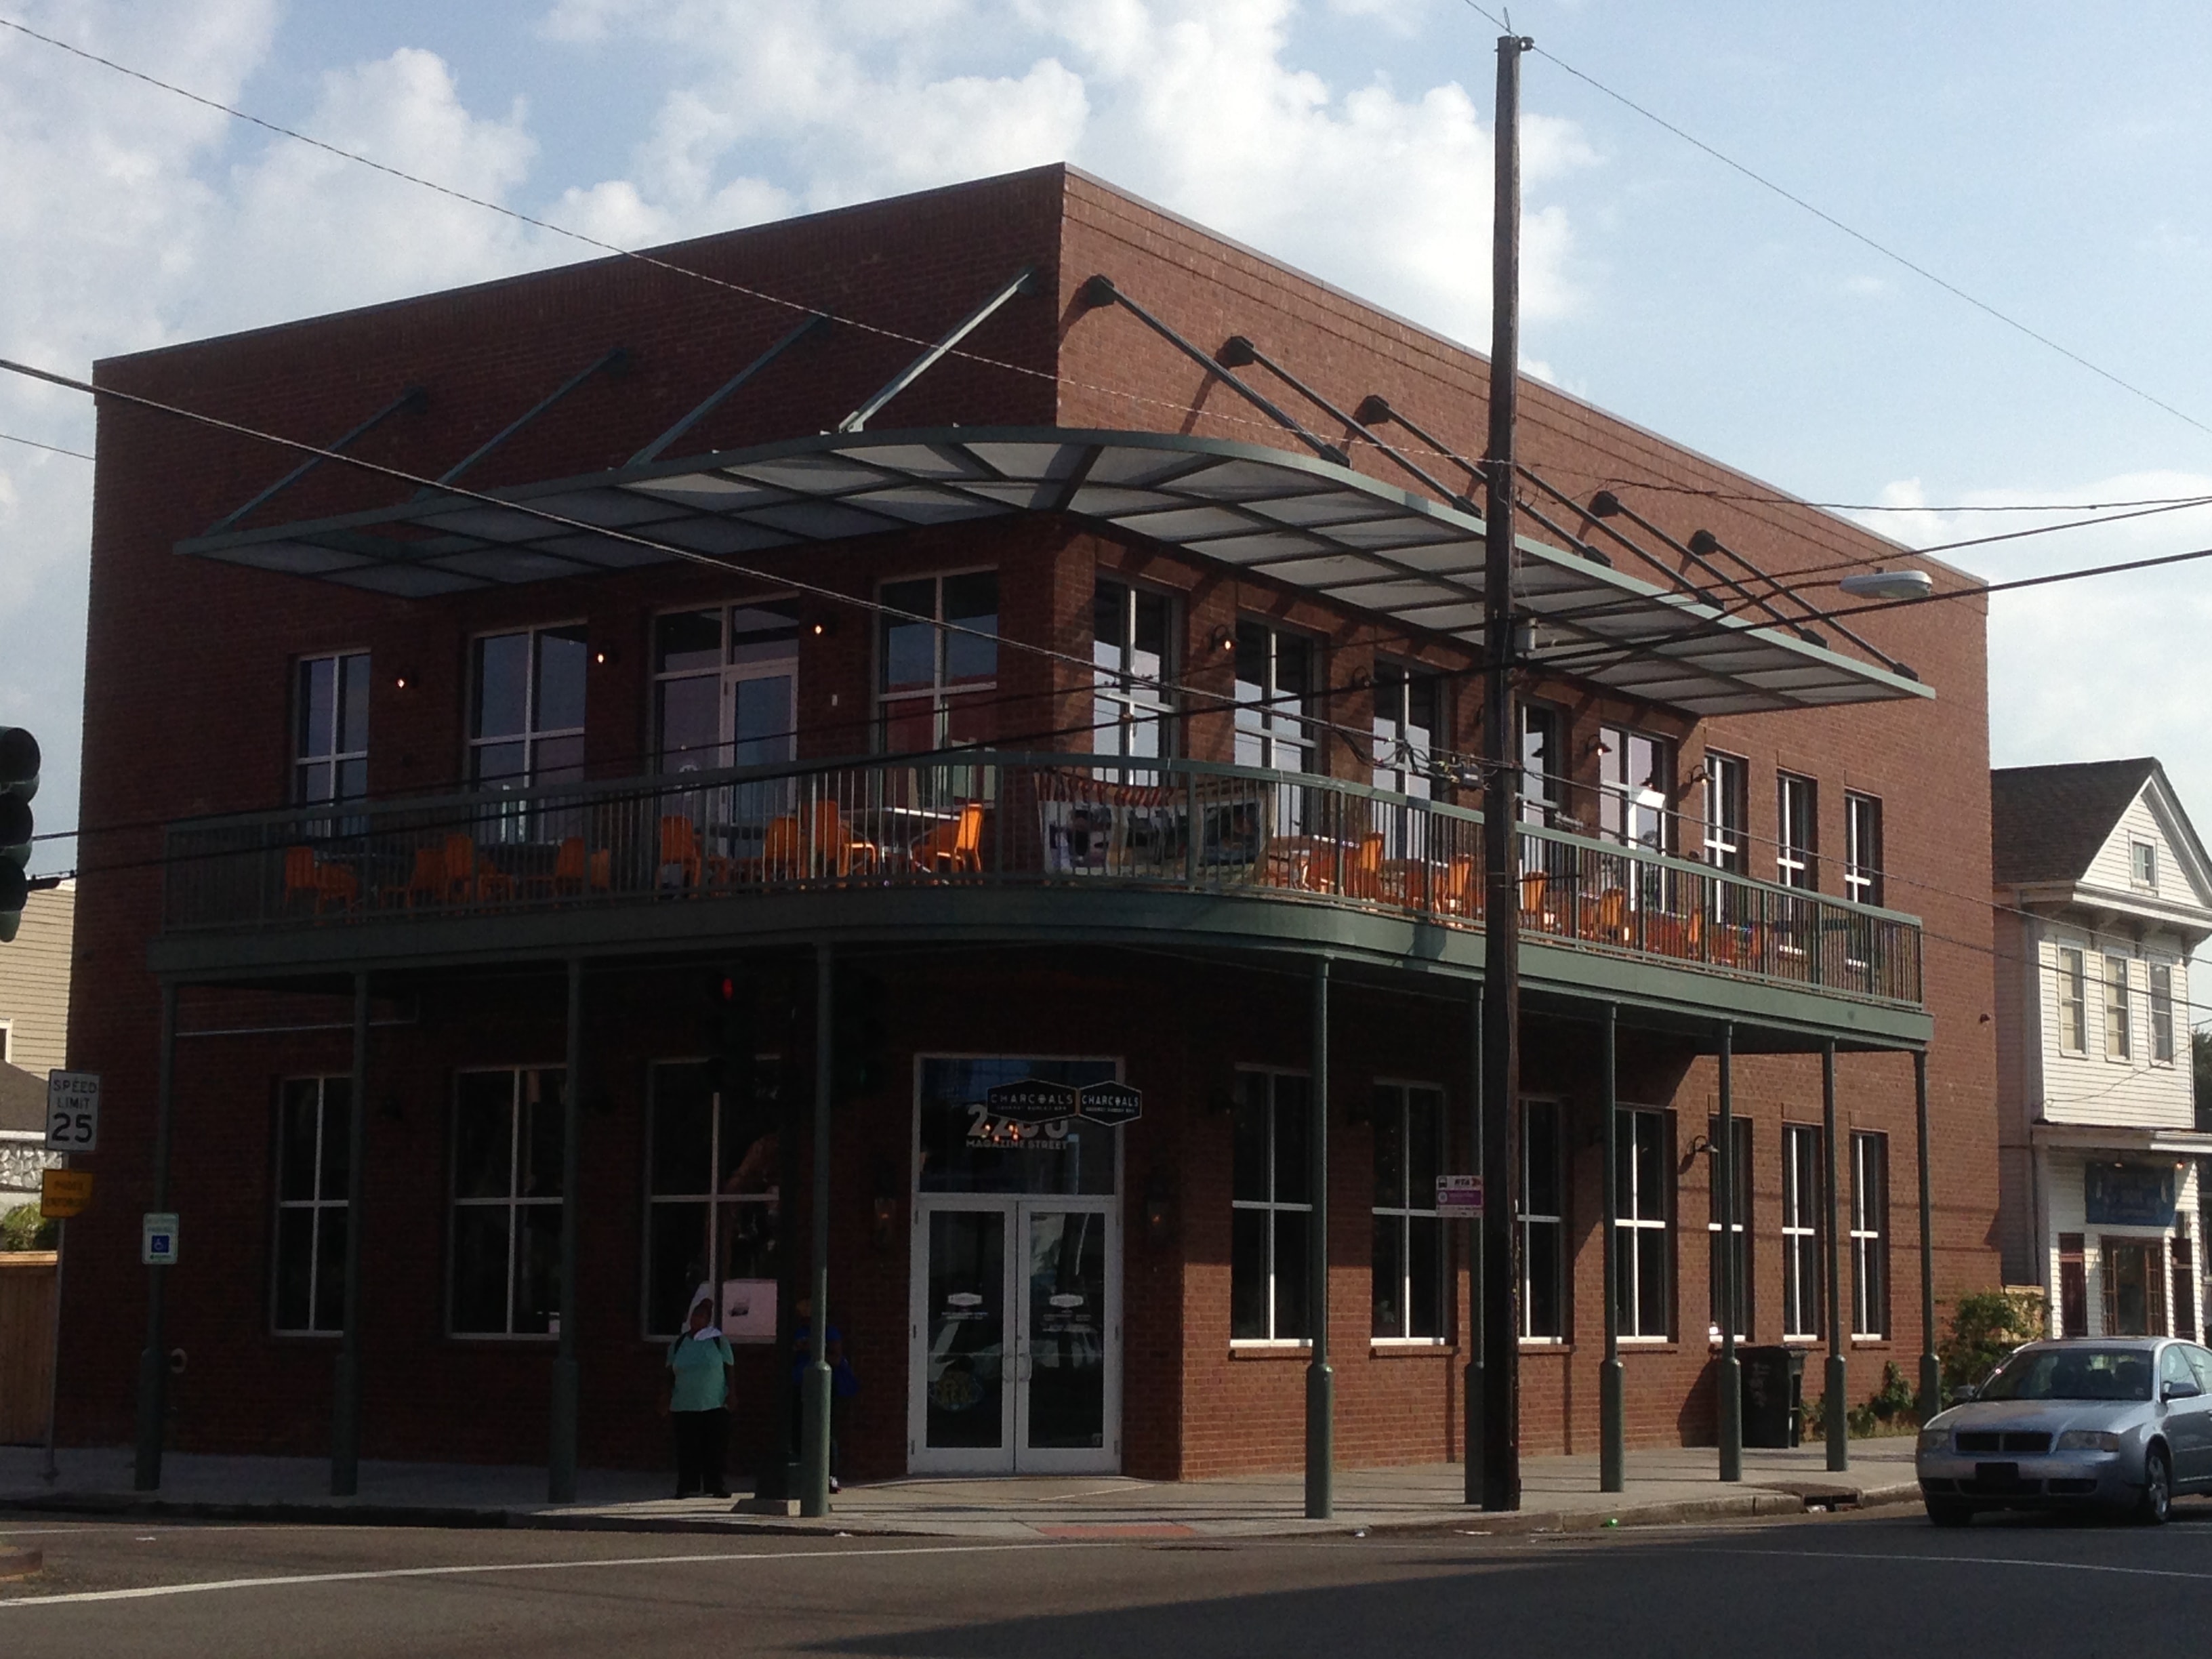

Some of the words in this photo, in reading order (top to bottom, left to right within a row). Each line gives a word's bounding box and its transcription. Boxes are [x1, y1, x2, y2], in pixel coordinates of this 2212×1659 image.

[53, 1079, 98, 1094] SPEED
[58, 1097, 90, 1110] LIMIT
[52, 1113, 93, 1143] 25
[966, 1139, 1025, 1149] MAGAZINE
[1028, 1140, 1067, 1149] STREET
